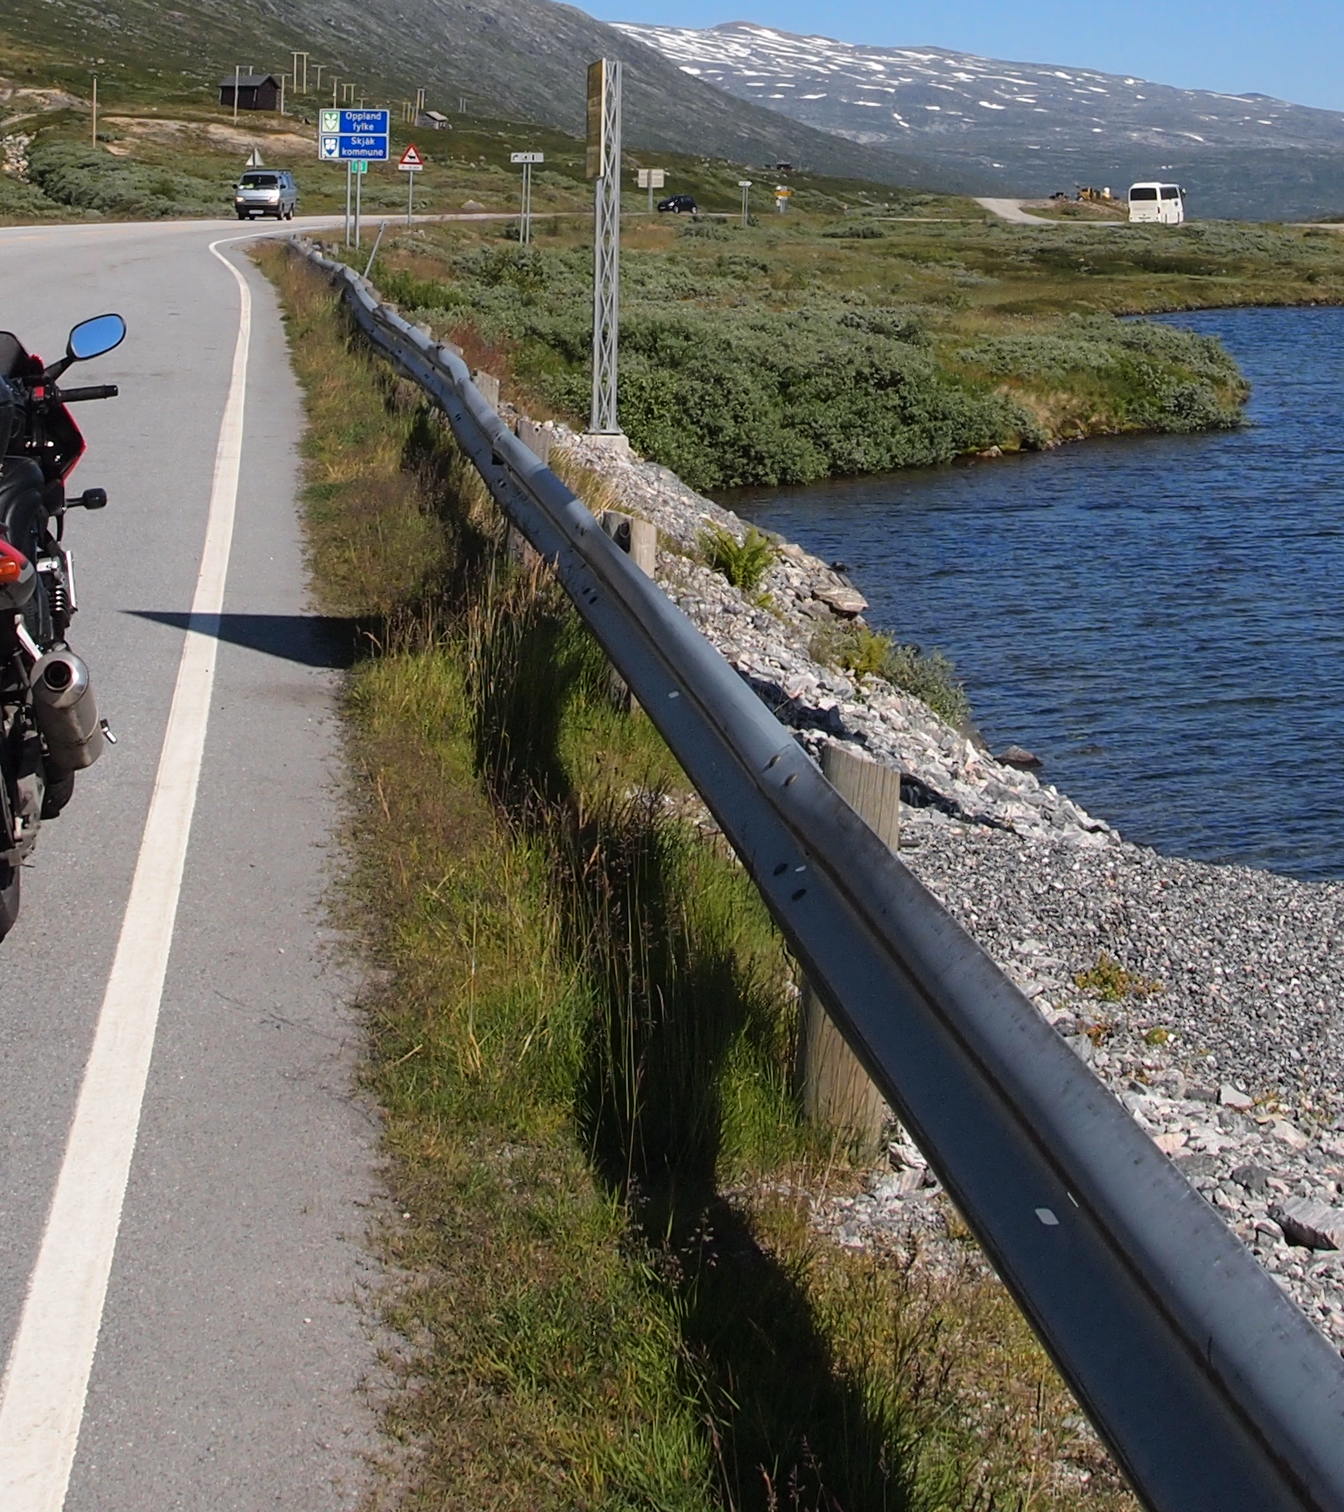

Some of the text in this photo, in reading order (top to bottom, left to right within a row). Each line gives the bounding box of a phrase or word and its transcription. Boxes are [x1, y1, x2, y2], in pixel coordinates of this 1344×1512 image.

[345, 111, 382, 121] Oppland
[353, 122, 375, 133] fylke
[341, 148, 384, 156] kommune
